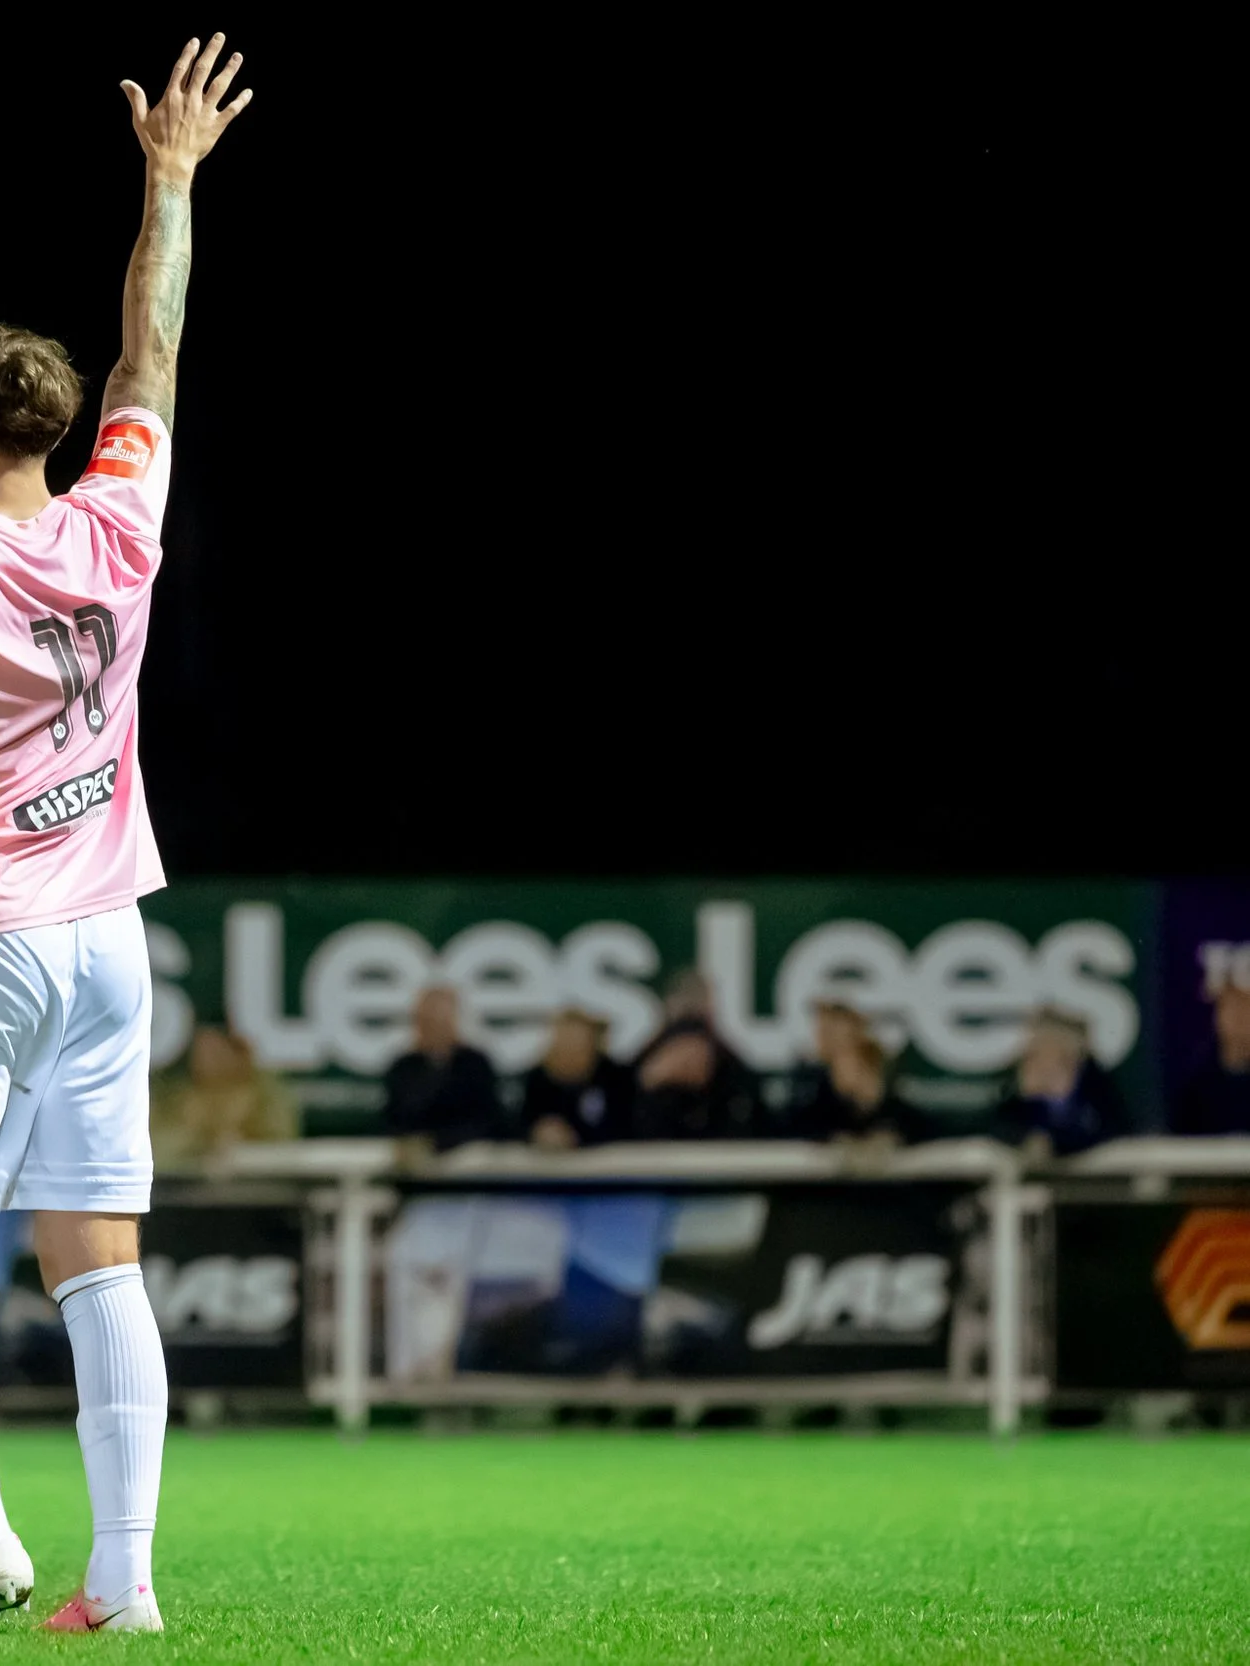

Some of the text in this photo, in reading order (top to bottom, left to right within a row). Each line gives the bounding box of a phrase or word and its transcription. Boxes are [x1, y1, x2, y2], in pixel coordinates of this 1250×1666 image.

[223, 902, 661, 1075] Lees
[695, 899, 1139, 1074] Lees
[748, 1253, 949, 1350] JAS
